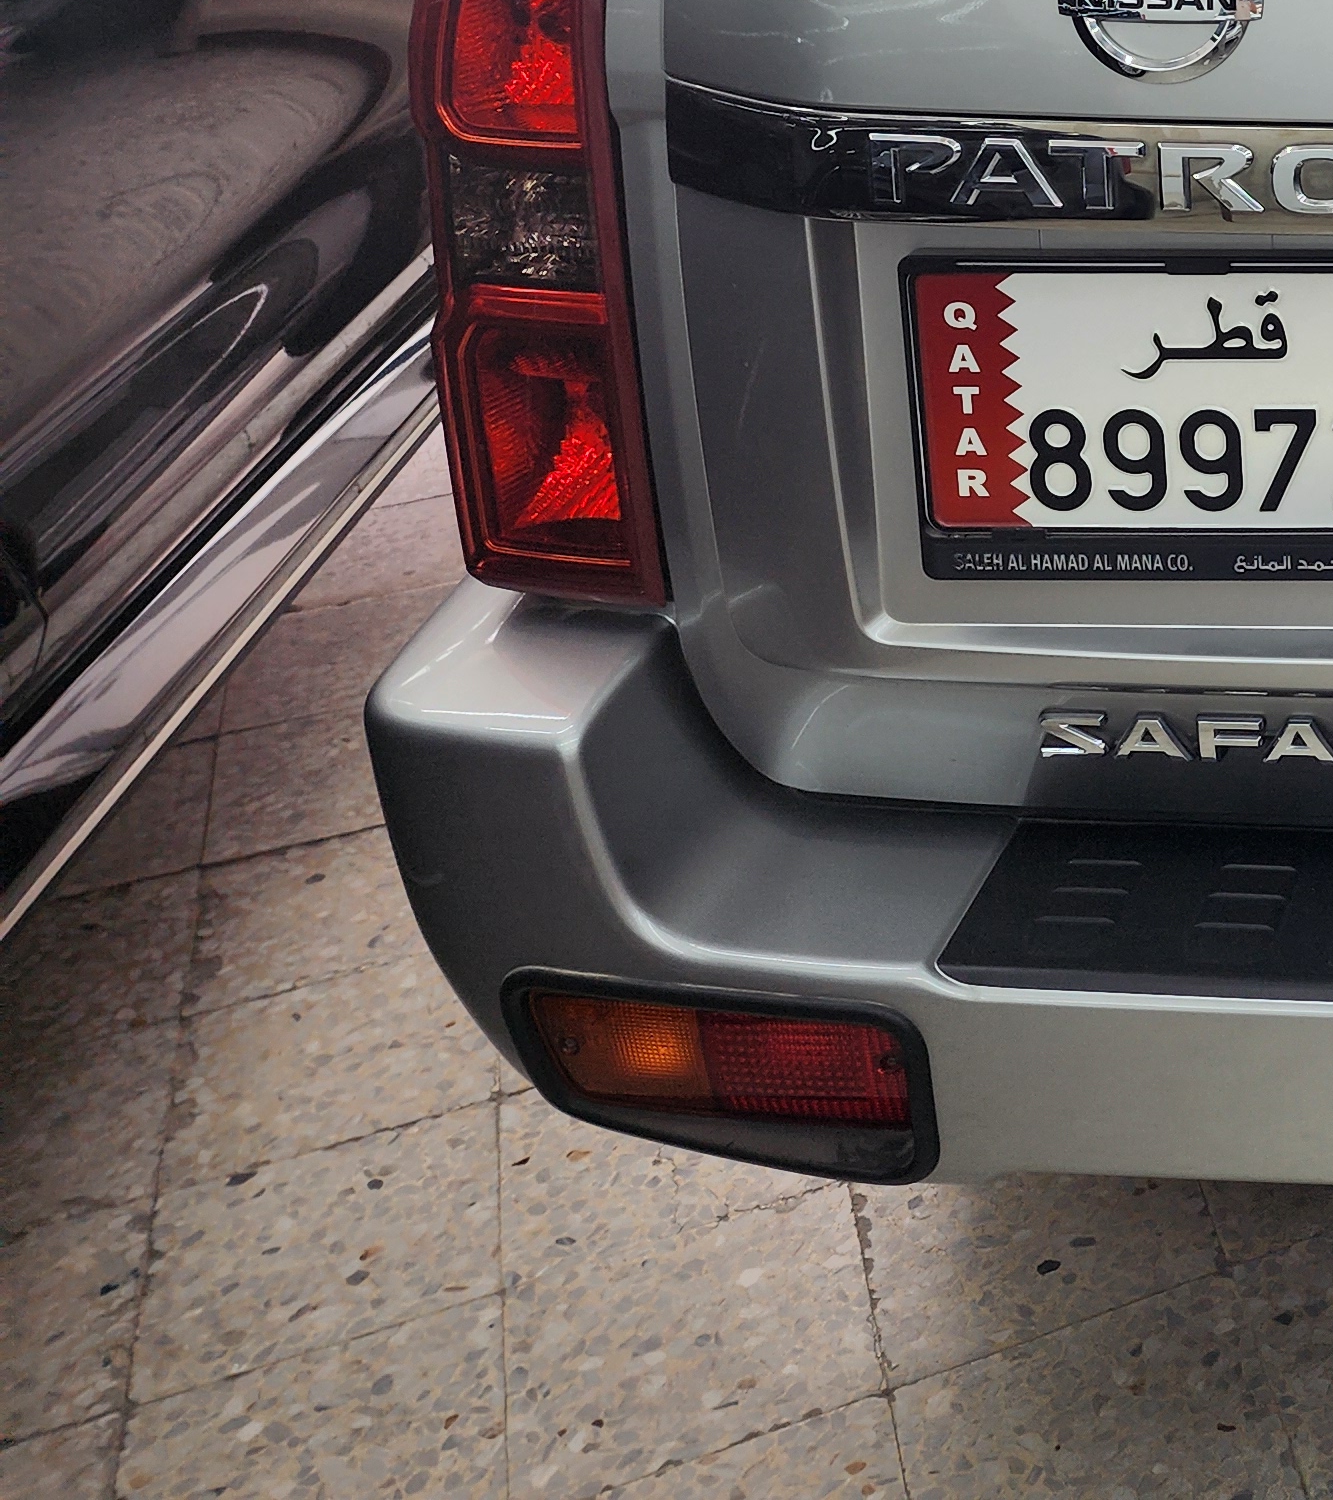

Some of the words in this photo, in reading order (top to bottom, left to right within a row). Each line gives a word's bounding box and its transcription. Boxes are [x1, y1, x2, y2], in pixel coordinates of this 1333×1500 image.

[1120, 288, 1289, 380] قطر
[942, 301, 991, 498] QATAR
[954, 553, 1004, 570] SALEH
[1008, 554, 1027, 570] AL
[1031, 554, 1088, 570] HAMAD
[1093, 554, 1112, 570] AL
[1117, 554, 1164, 571] MANA
[1167, 554, 1194, 572] CO.
[1233, 555, 1292, 573] المانع
